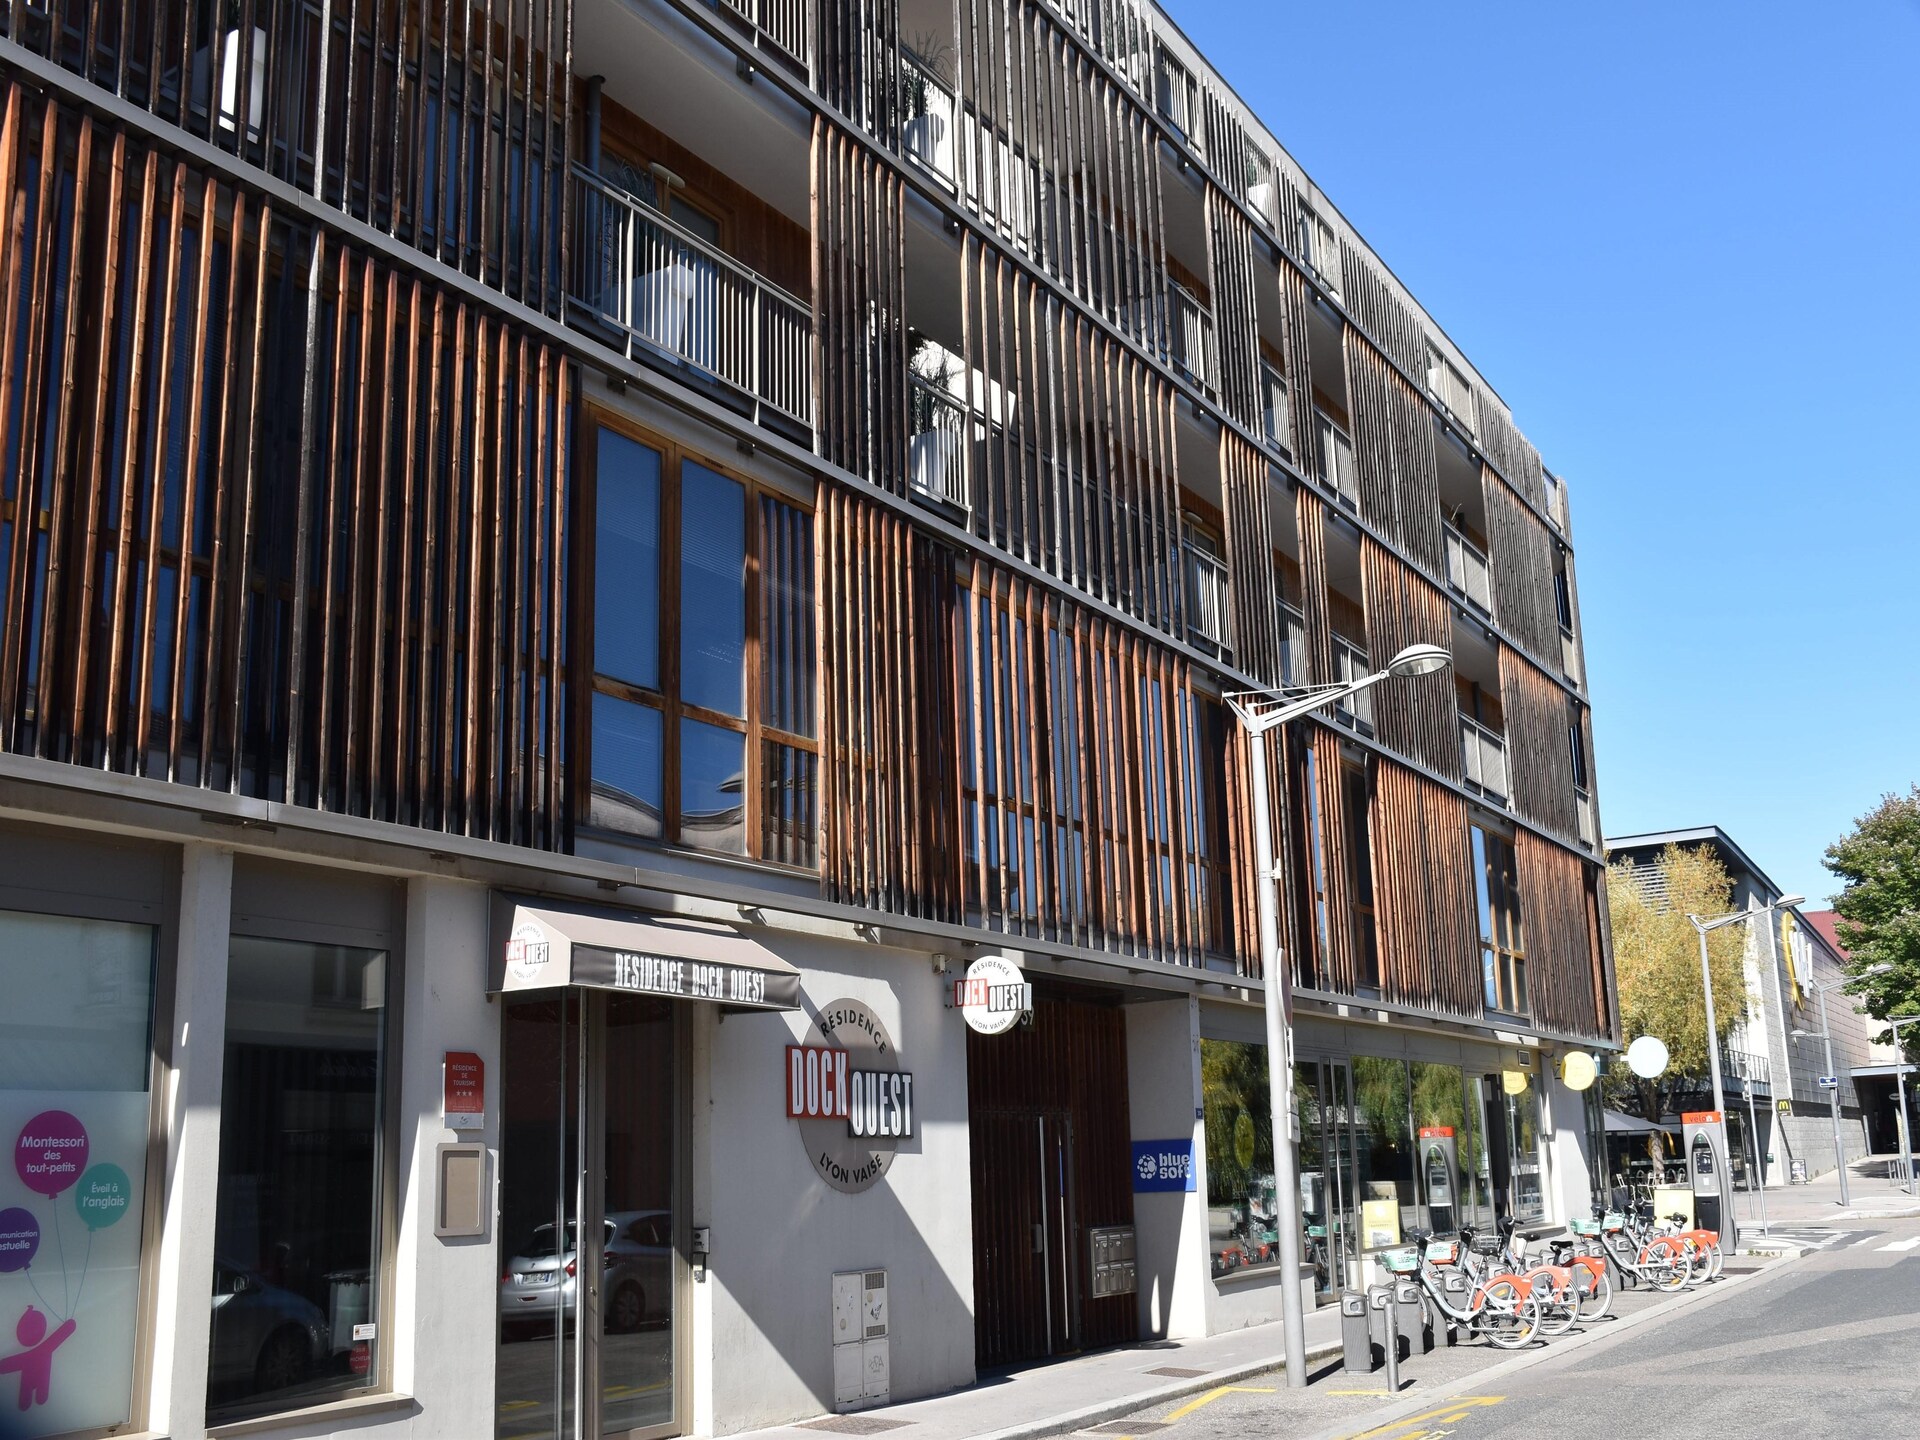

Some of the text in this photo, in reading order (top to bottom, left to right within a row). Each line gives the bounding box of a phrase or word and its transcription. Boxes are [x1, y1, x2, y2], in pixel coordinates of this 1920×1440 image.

[692, 964, 724, 998] DOCK
[730, 969, 765, 1003] OUEST
[957, 979, 986, 1006] DOCK
[989, 984, 1023, 1011] OUEST
[972, 1017, 1007, 1030] LYON VAISE
[820, 1009, 887, 1054] RÉSIDENCE
[791, 1048, 848, 1116] DOCK
[852, 1071, 912, 1136] OUEST
[21, 1135, 85, 1148] Montessori
[43, 1150, 61, 1160] des
[1158, 1153, 1190, 1167] blue
[26, 1162, 76, 1175] tout-petits
[820, 1152, 883, 1183] LYON VAISE
[1159, 1164, 1191, 1179] soft
[91, 1182, 118, 1193] Éveil à
[83, 1196, 125, 1209] l'anglais
